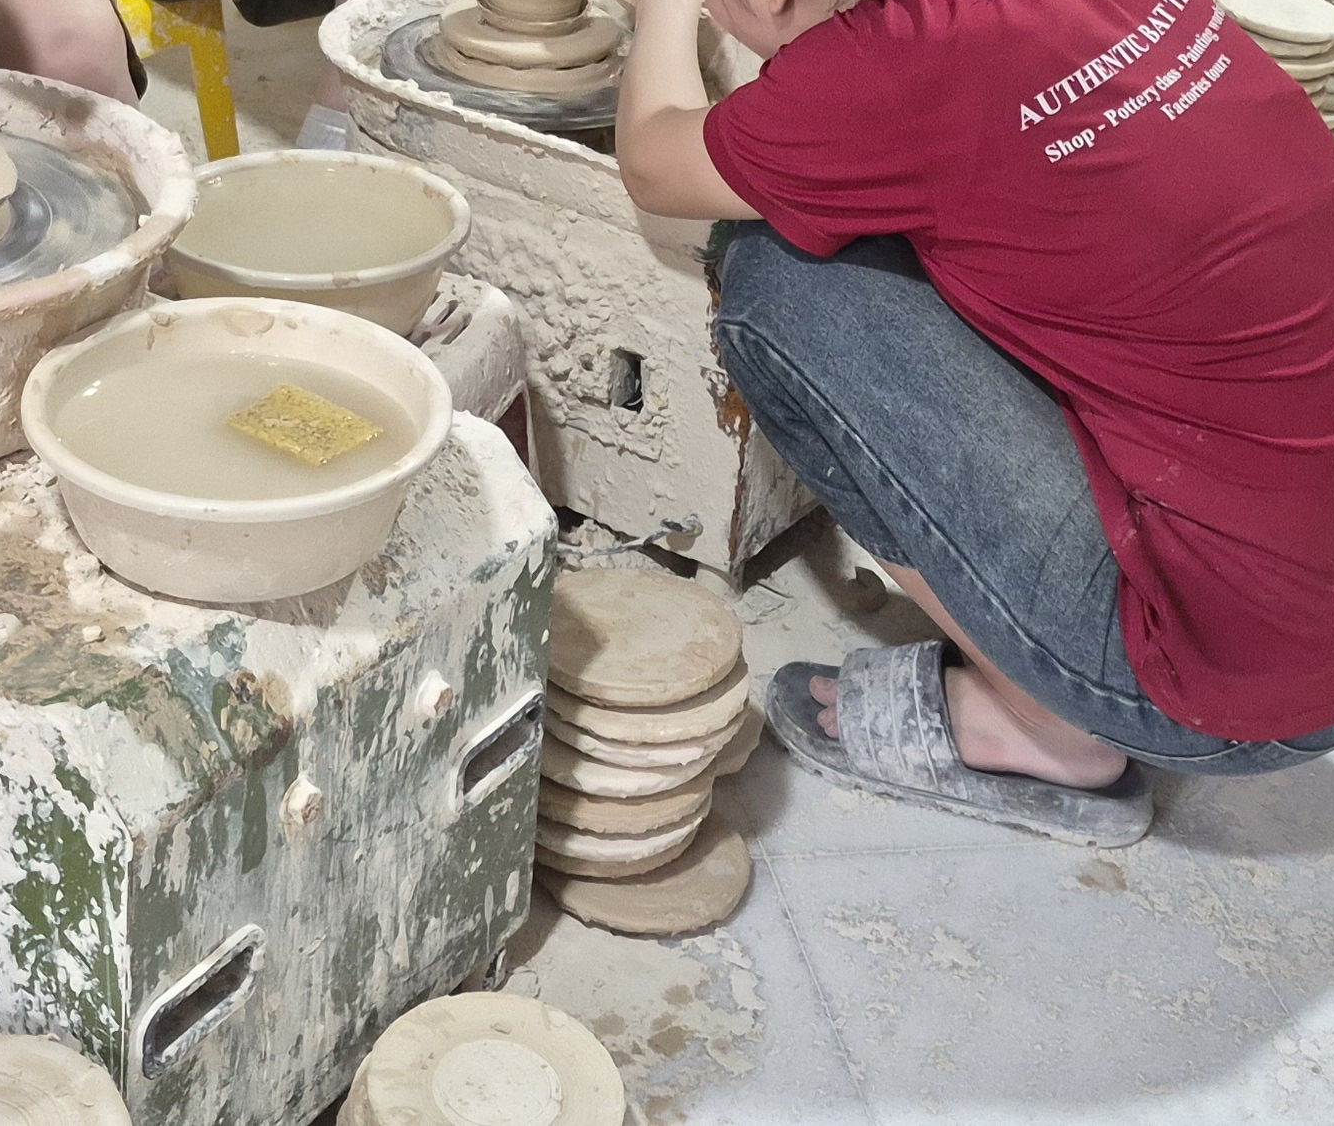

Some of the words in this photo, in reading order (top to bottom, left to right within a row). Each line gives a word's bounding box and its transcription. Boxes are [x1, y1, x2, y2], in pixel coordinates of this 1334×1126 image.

[1020, 33, 1150, 132] AUTHENTIC
[1137, 2, 1177, 44] BAT
[1044, 127, 1096, 164] Shop
[1103, 85, 1162, 128] Pottery
[1155, 69, 1182, 92] class
[1176, 27, 1220, 69] Painting
[1160, 76, 1213, 122] Factories
[1203, 53, 1232, 82] tours
